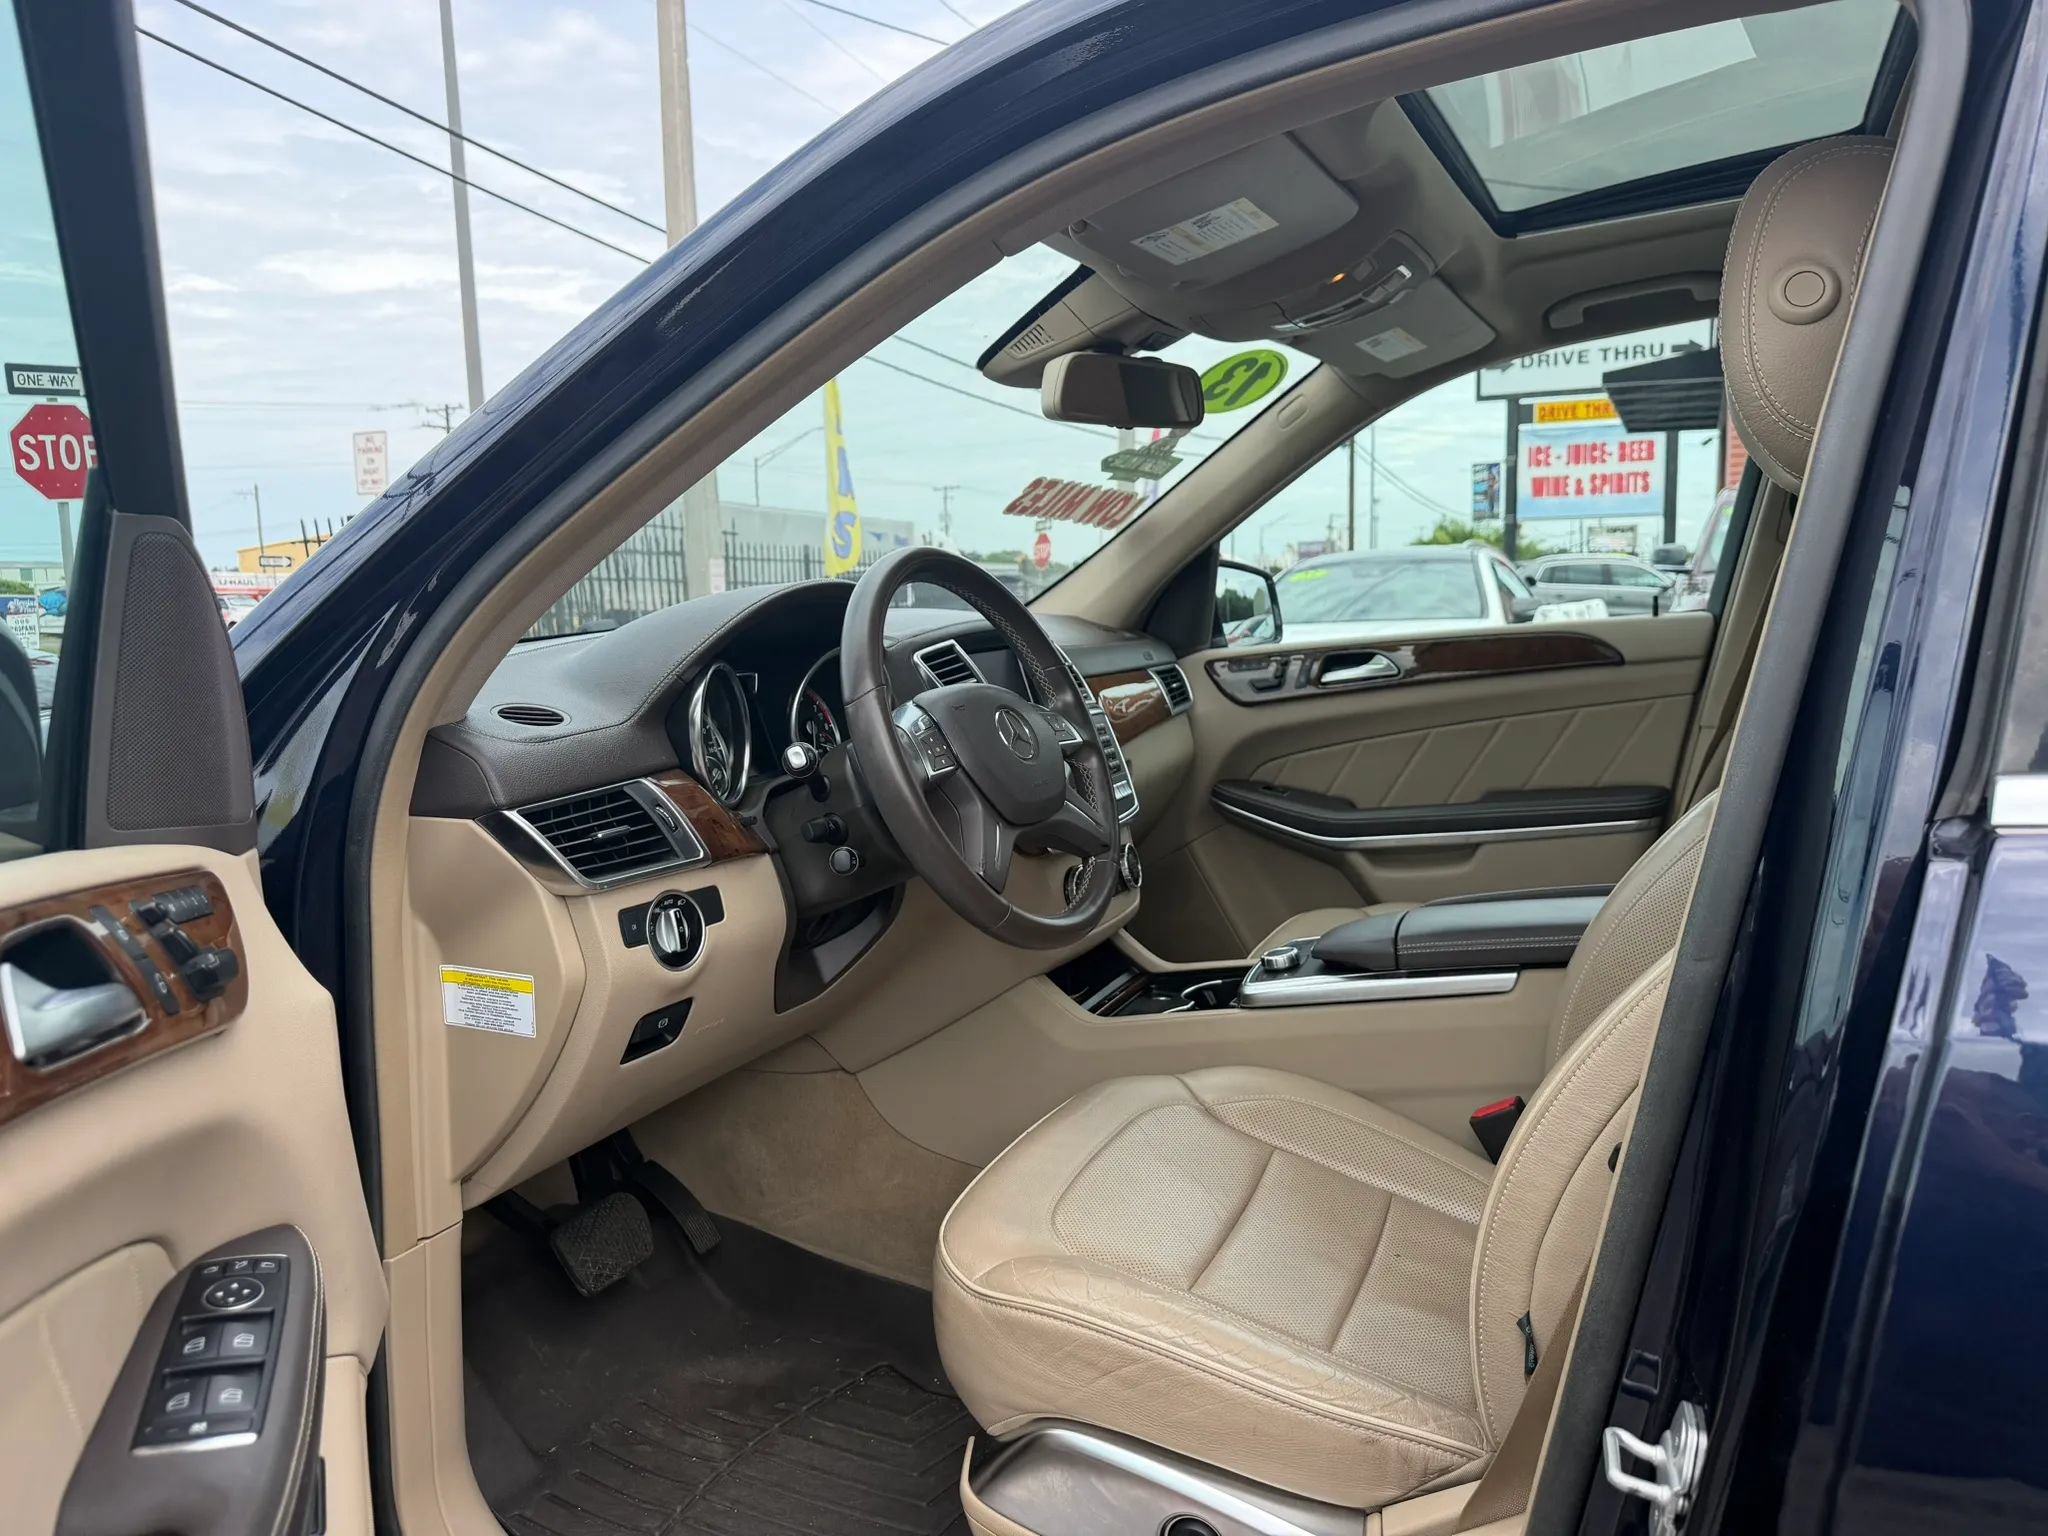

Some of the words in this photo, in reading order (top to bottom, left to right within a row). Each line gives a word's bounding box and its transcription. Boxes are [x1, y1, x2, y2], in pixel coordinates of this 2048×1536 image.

[1521, 349, 1590, 369] DRIVE
[1599, 343, 1665, 363] THRU
[17, 373, 45, 387] ONE
[49, 375, 76, 388] WAY
[1538, 403, 1577, 421] DRIVE
[1528, 446, 1551, 468] ICE
[1618, 440, 1656, 462] BEER
[1532, 475, 1569, 498] WINE
[1575, 478, 1584, 496] &
[1589, 471, 1650, 495] SPIRITS
